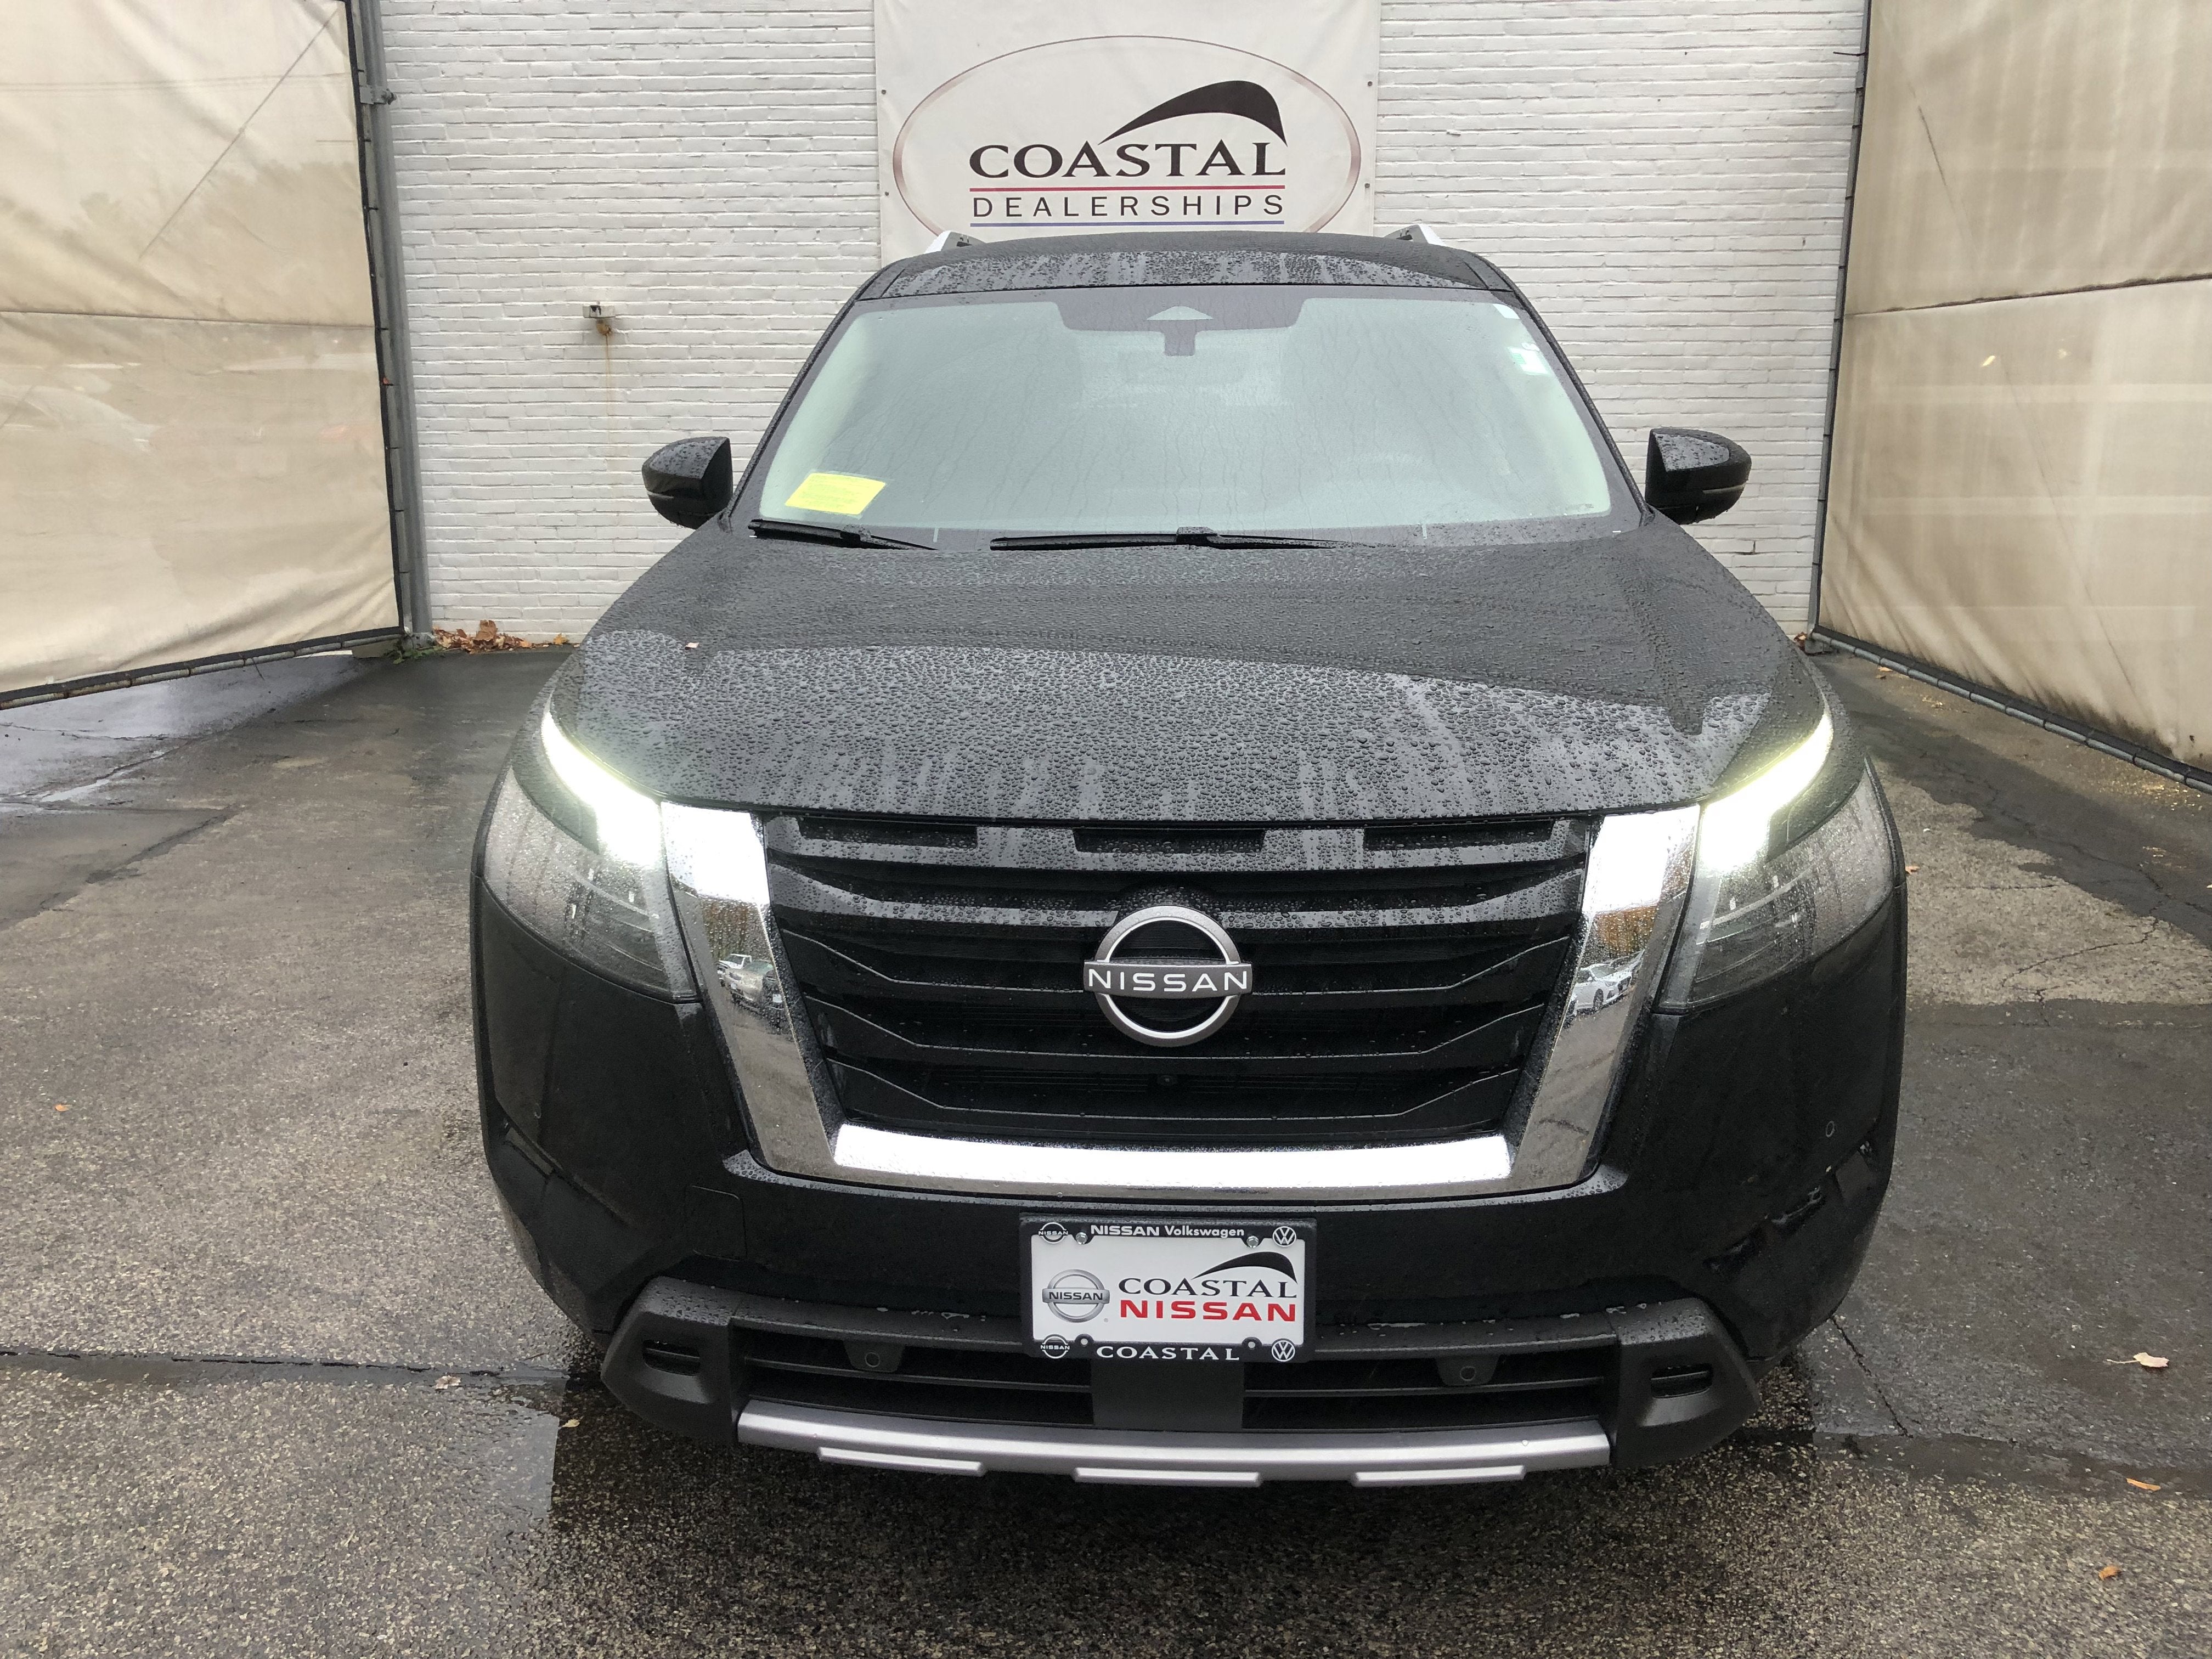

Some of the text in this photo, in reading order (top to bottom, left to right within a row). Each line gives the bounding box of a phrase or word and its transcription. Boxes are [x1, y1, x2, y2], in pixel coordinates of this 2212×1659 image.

[969, 139, 1286, 178] COASTAL
[973, 194, 1283, 217] DEALERSHIPS
[1088, 969, 1247, 992] NISSAN
[1091, 1224, 1244, 1238] NISSAN Volkswagen
[1049, 1291, 1103, 1300] NISSAN
[1119, 1277, 1297, 1299] COASTAL
[1120, 1300, 1295, 1322] NISSAN
[1097, 1346, 1240, 1361] COASTAL
